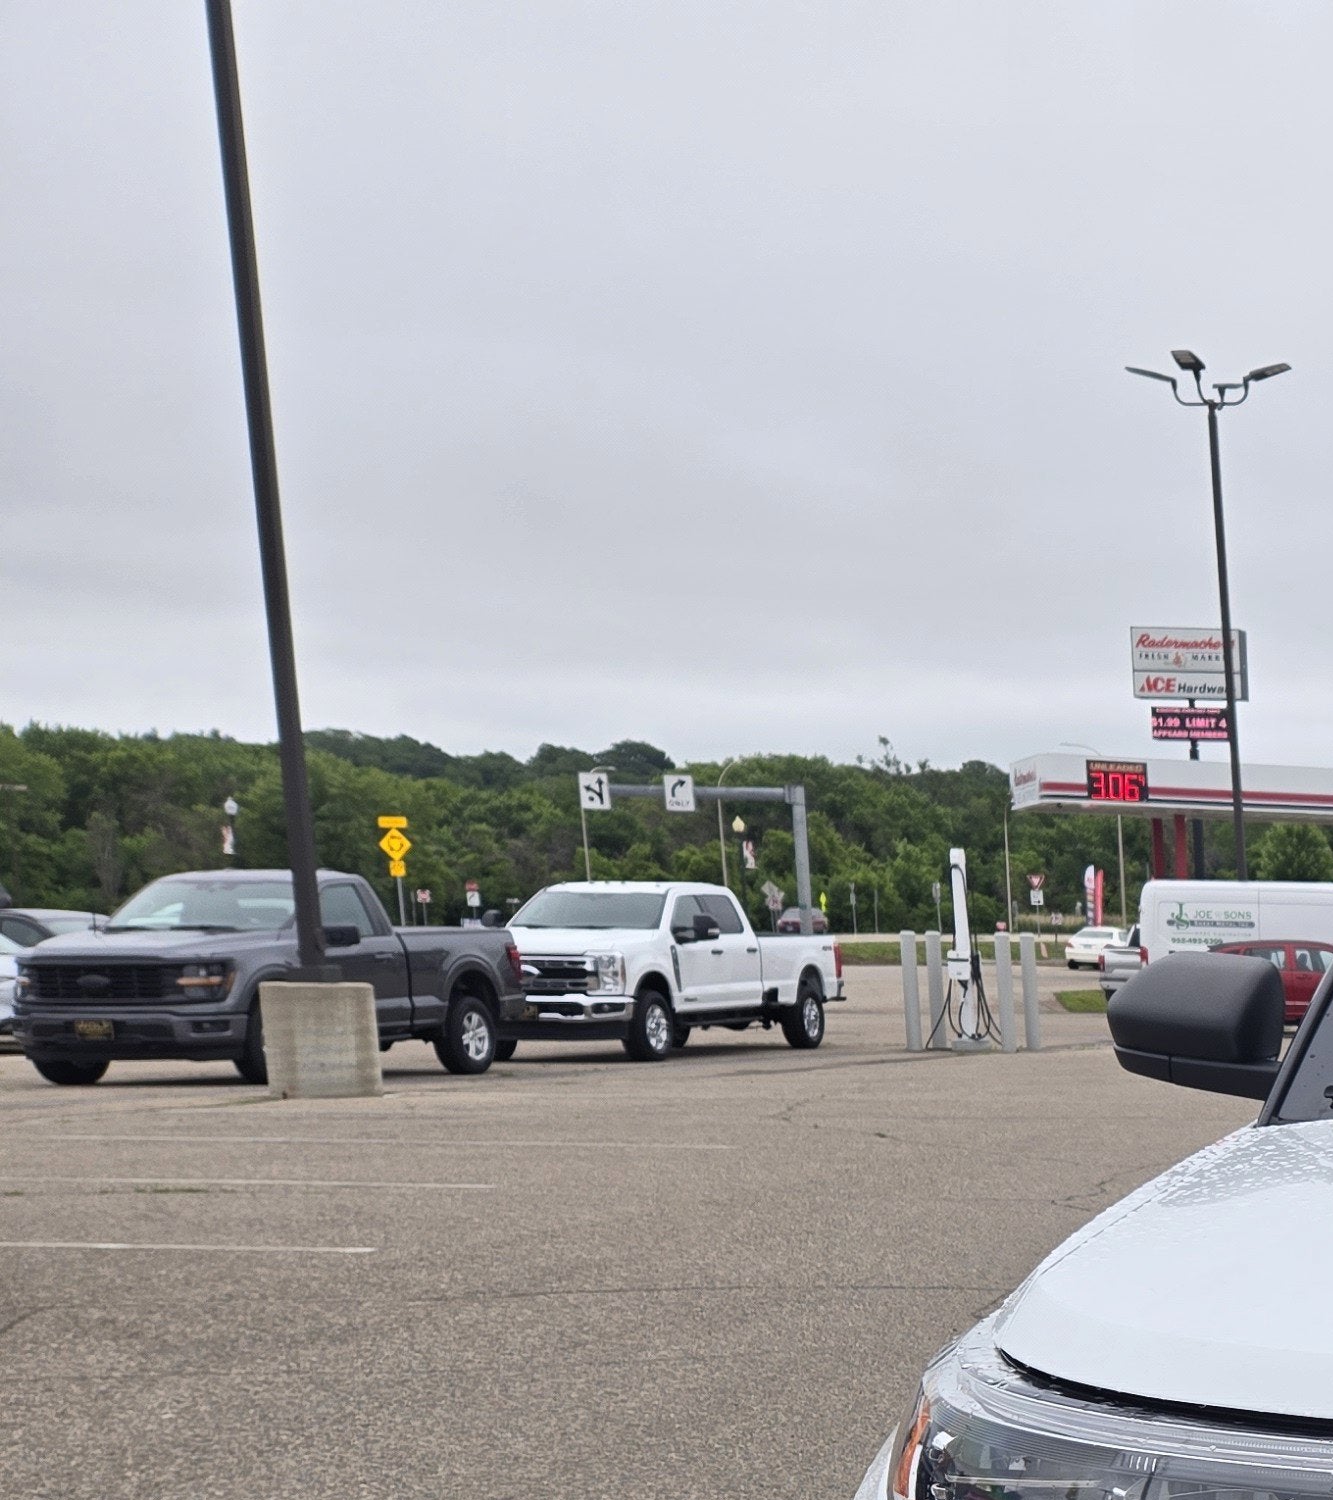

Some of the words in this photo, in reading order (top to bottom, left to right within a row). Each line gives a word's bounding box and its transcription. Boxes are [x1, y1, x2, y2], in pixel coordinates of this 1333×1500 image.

[1139, 675, 1176, 693] ACE
[1177, 683, 1227, 694] Hardwa
[1185, 717, 1216, 728] LIMIT
[1194, 910, 1212, 919] JOE
[1224, 911, 1252, 919] SONS
